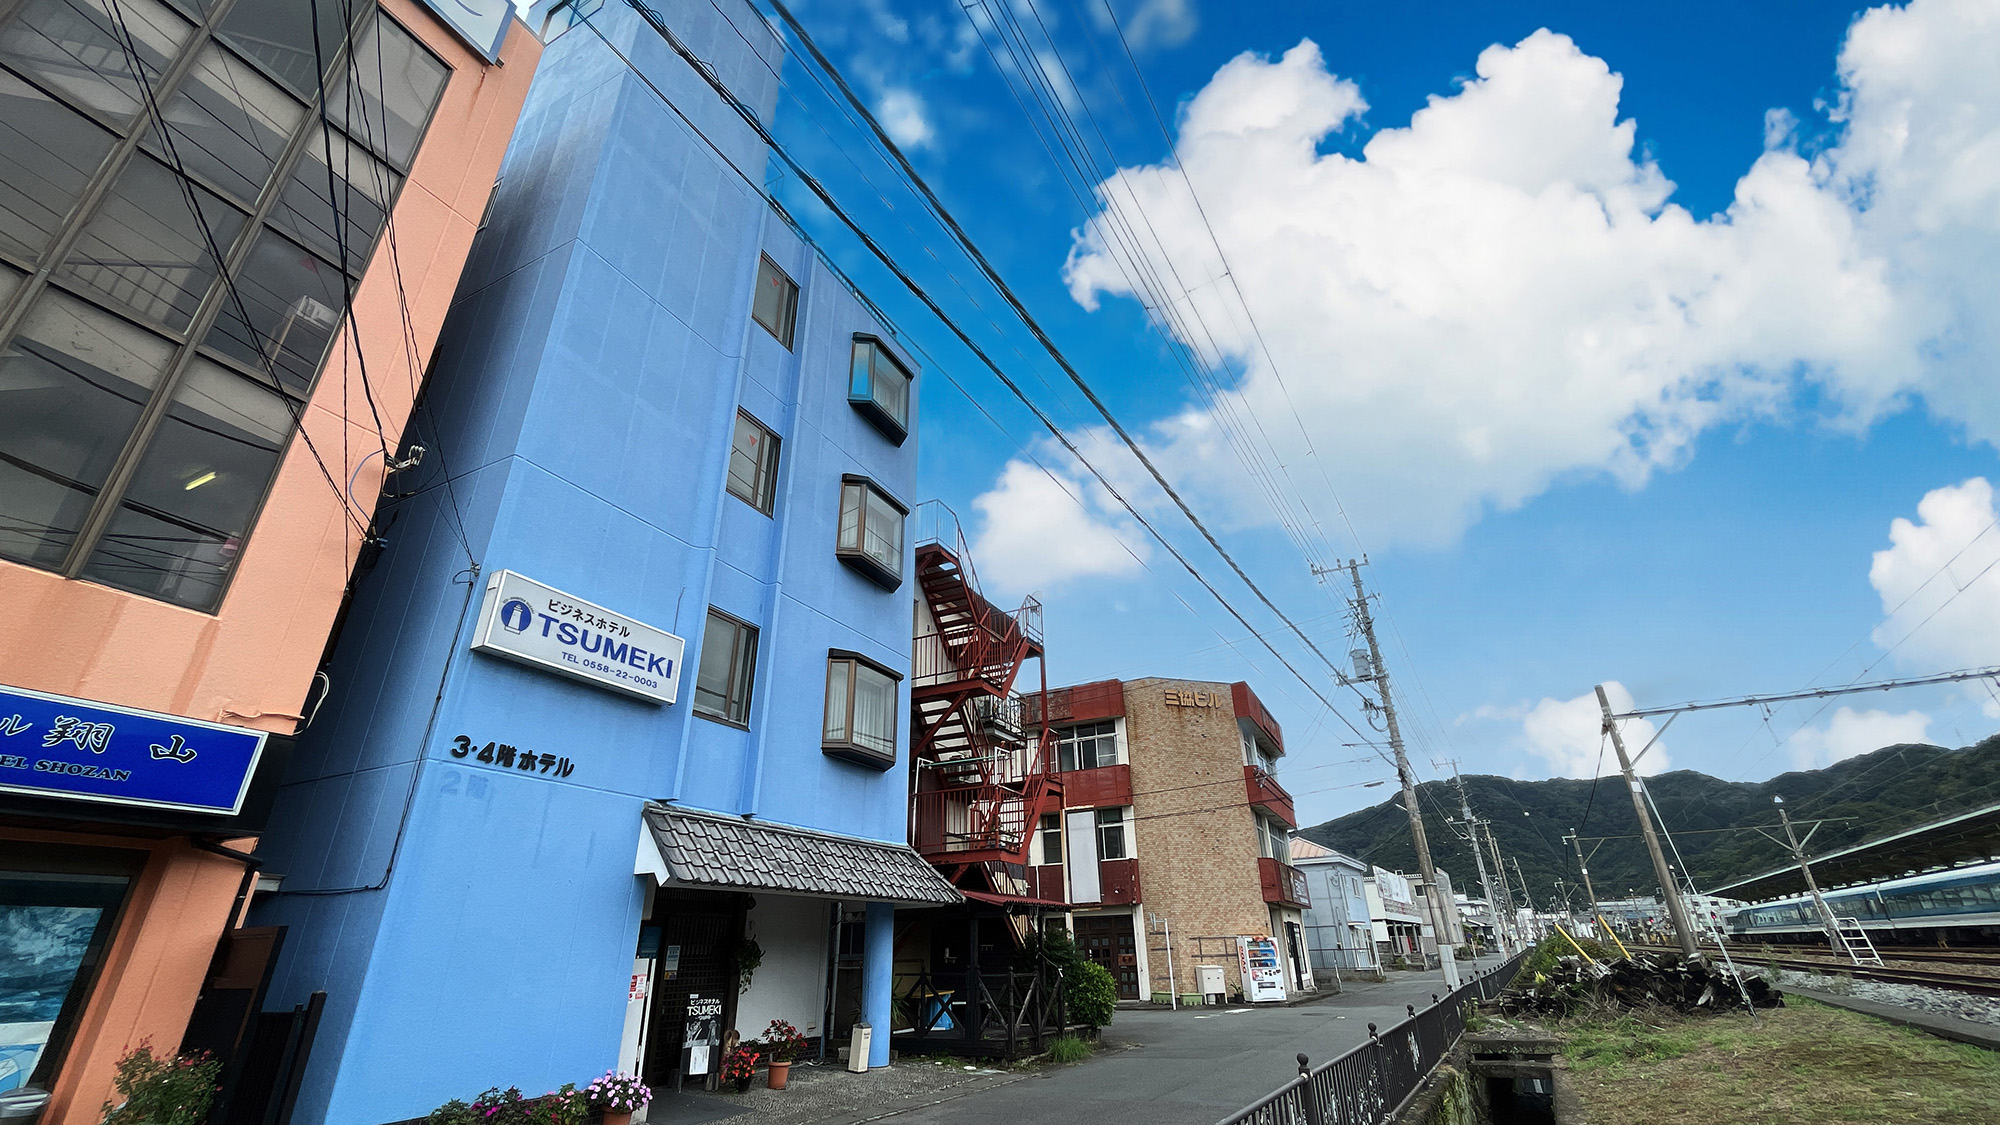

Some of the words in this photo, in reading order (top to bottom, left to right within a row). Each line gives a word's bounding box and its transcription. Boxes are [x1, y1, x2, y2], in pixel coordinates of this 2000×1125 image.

[548, 598, 631, 638] ビジネスホテル
[538, 613, 674, 679] TSUMEKI
[562, 651, 579, 664] TEL
[583, 658, 658, 689] 0558-22-0003
[33, 759, 132, 782] SHOZAN
[686, 1004, 722, 1017] TSUMEKI
